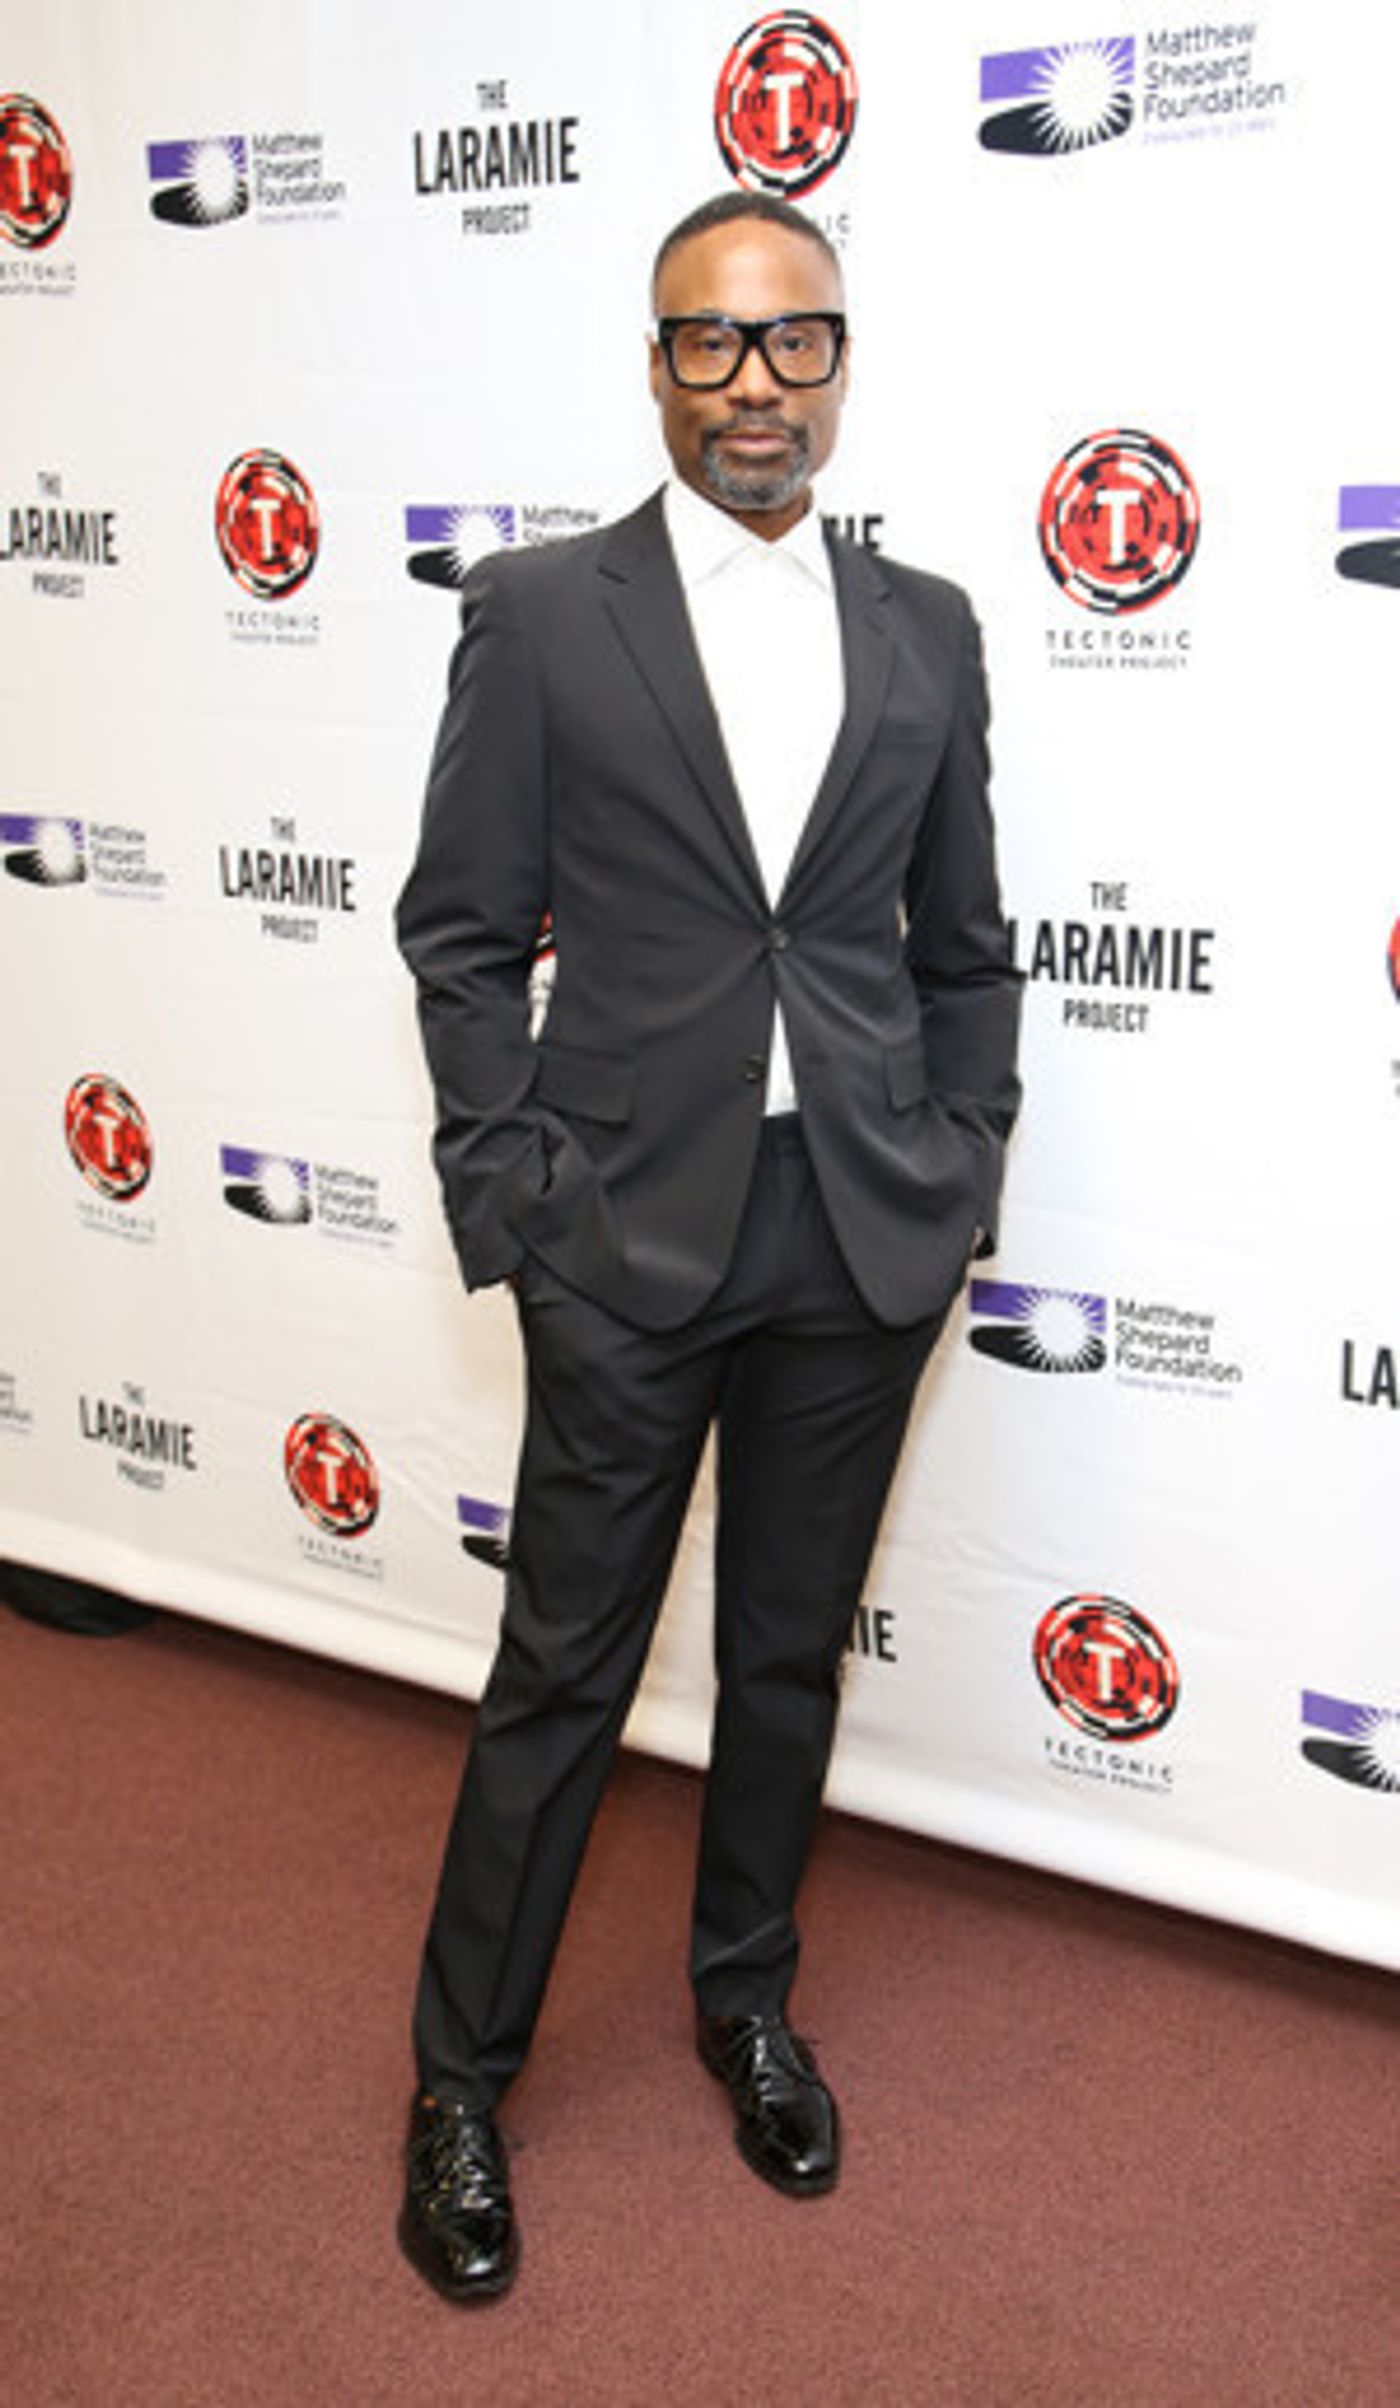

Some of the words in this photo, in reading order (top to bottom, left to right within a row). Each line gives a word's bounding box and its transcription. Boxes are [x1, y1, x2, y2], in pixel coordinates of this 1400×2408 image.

[1146, 24, 1256, 56] Matthew
[1145, 51, 1251, 89] Shepard
[476, 80, 508, 110] THE
[1144, 80, 1284, 121] Foundation
[763, 72, 804, 152] T
[252, 134, 322, 155] Matthew
[413, 116, 580, 195] LARAMIE
[258, 181, 345, 206] Foundation
[462, 203, 530, 234] PROJECT
[251, 499, 281, 559] T
[522, 504, 599, 527] Matthew
[1097, 490, 1141, 565] T
[32, 571, 84, 598] PROJECT
[1045, 629, 1190, 650] TECTONIC
[219, 846, 356, 911] LARAMIE
[1090, 881, 1127, 912] THE
[261, 914, 318, 943] PROJECT
[1063, 998, 1149, 1032] PROJECT
[318, 1202, 399, 1233] Foundation
[1116, 1298, 1215, 1330] Matthew
[1116, 1321, 1210, 1354] Shepard
[1116, 1345, 1243, 1382] Foundation
[79, 1395, 197, 1471] LARAMIE
[1083, 1642, 1125, 1701] T
[1045, 1738, 1172, 1783] TECTONIC
